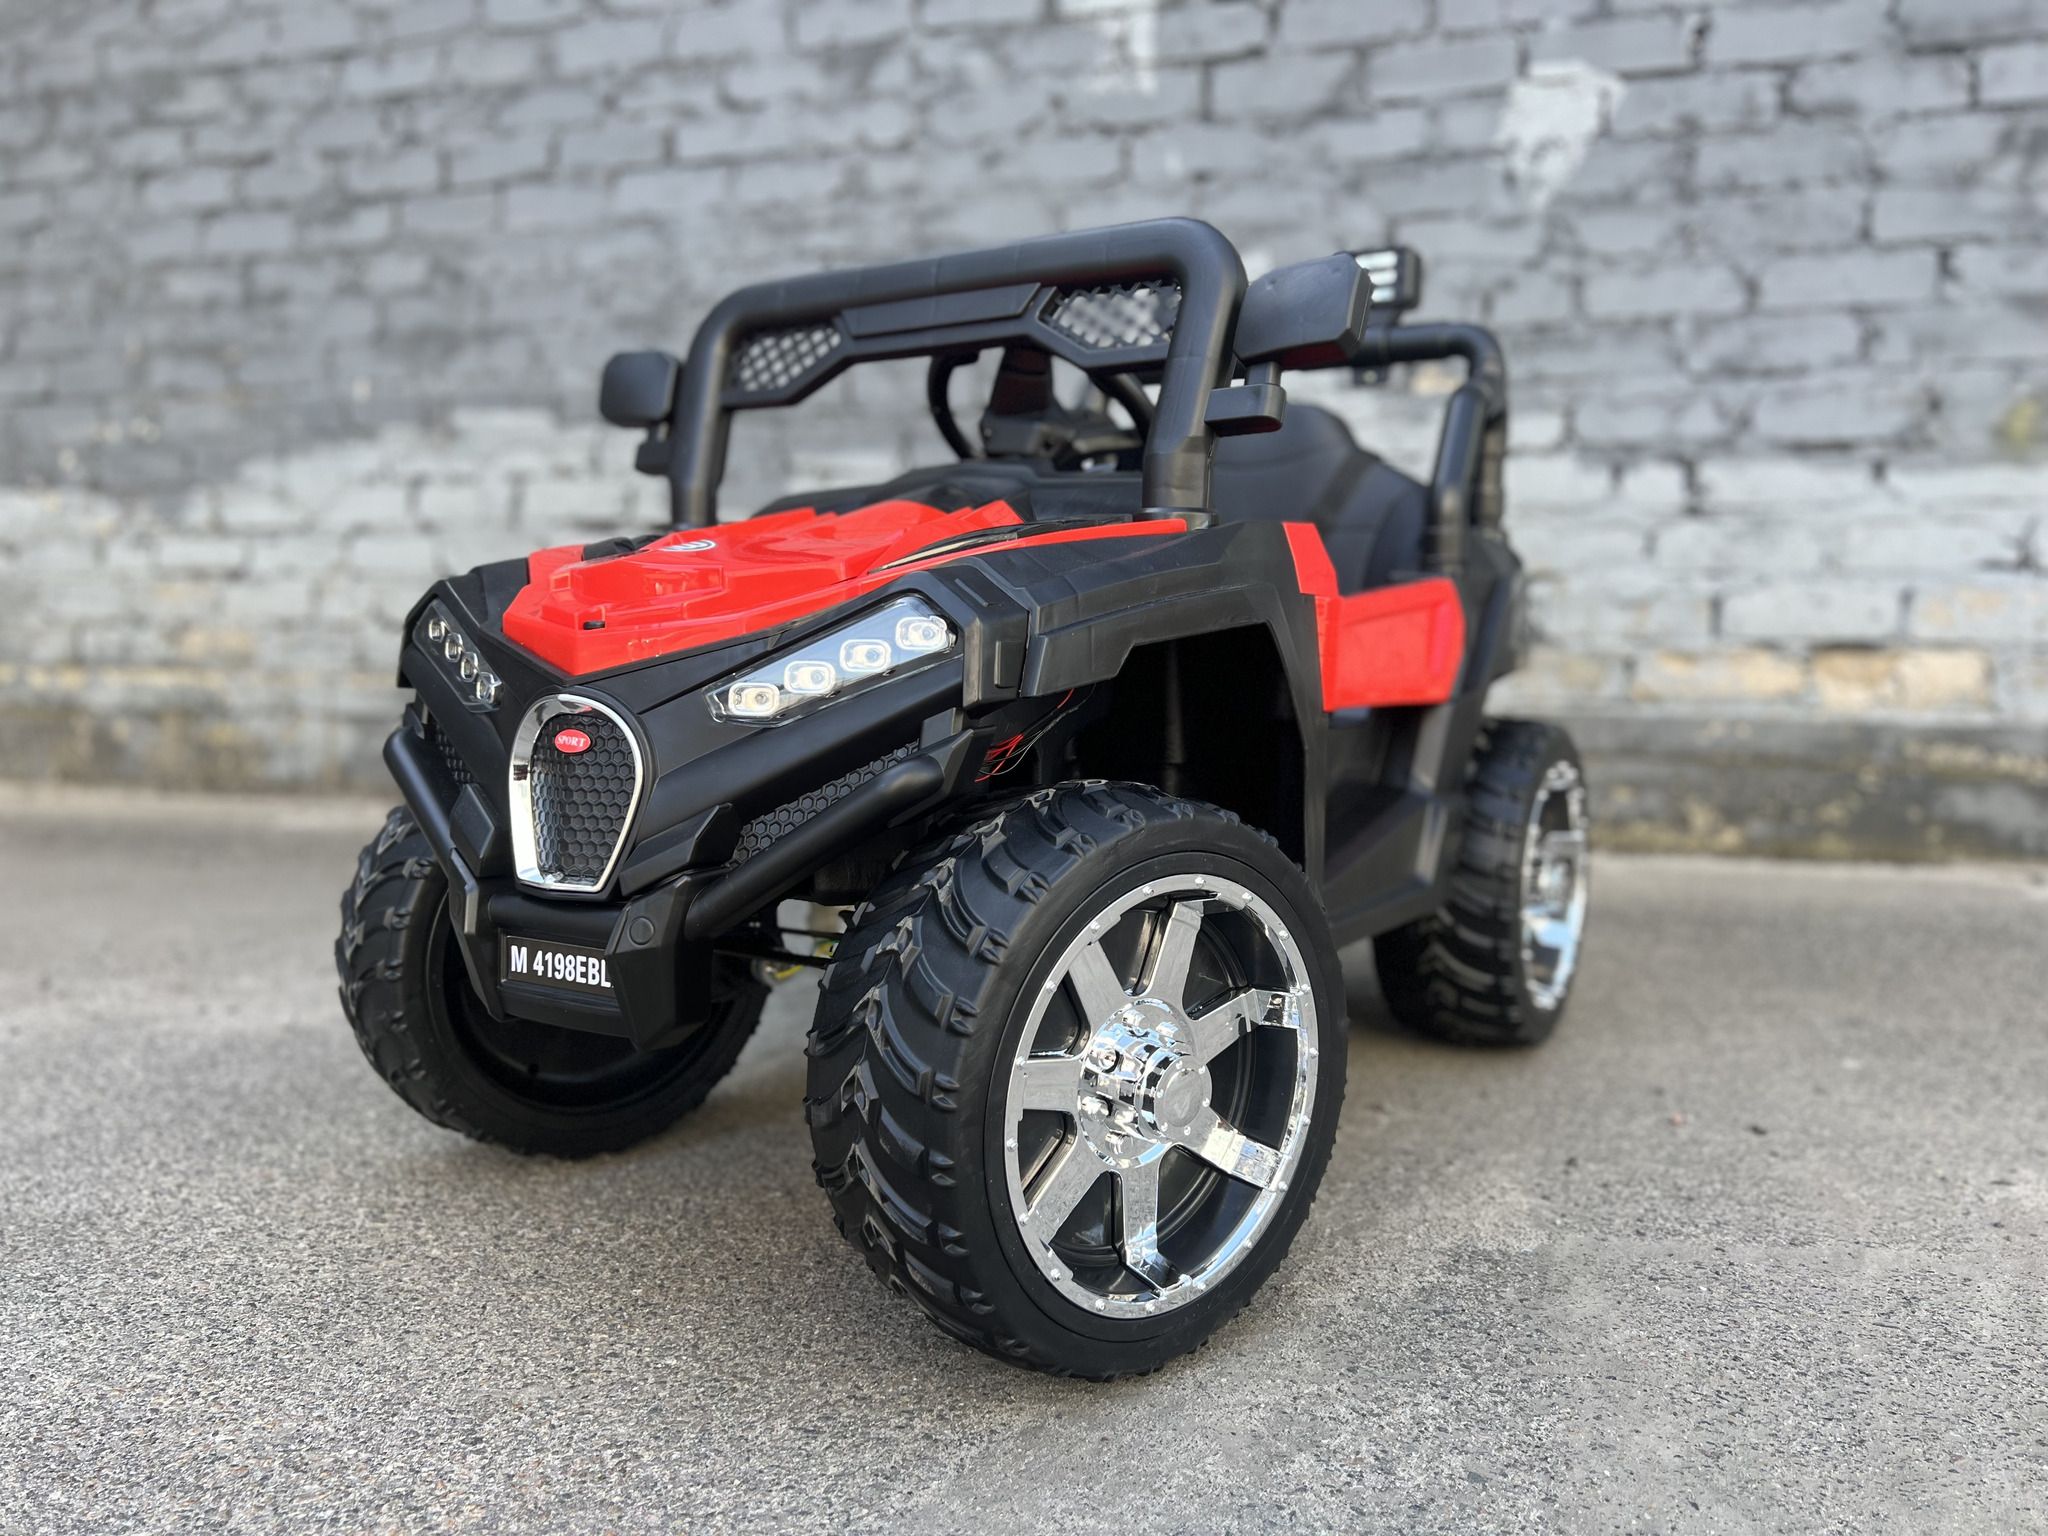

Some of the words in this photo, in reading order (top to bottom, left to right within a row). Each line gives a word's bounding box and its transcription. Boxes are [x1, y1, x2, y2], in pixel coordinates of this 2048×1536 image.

[557, 735, 586, 747] SPORT
[510, 945, 528, 974] M
[532, 950, 613, 989] 4198EBL
